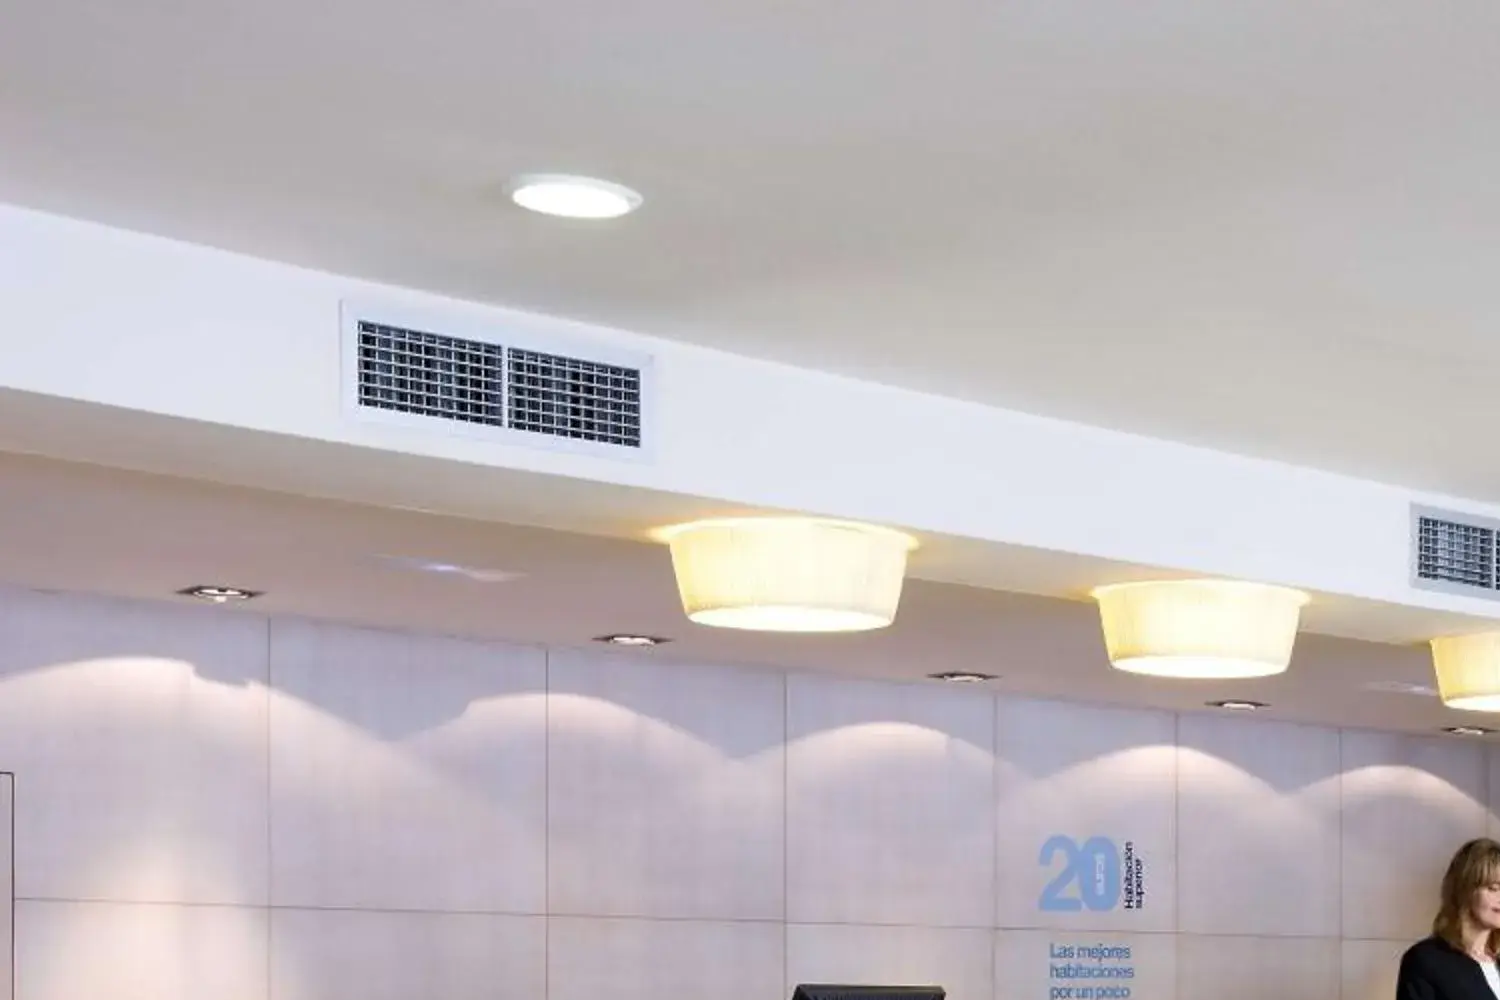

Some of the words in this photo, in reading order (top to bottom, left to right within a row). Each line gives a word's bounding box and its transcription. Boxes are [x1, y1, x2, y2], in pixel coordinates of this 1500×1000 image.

[1038, 834, 1121, 912] 20
[1050, 943, 1075, 959] Las
[1077, 943, 1131, 962] mejores
[1050, 963, 1135, 979] habitaciones
[1076, 986, 1093, 999] un
